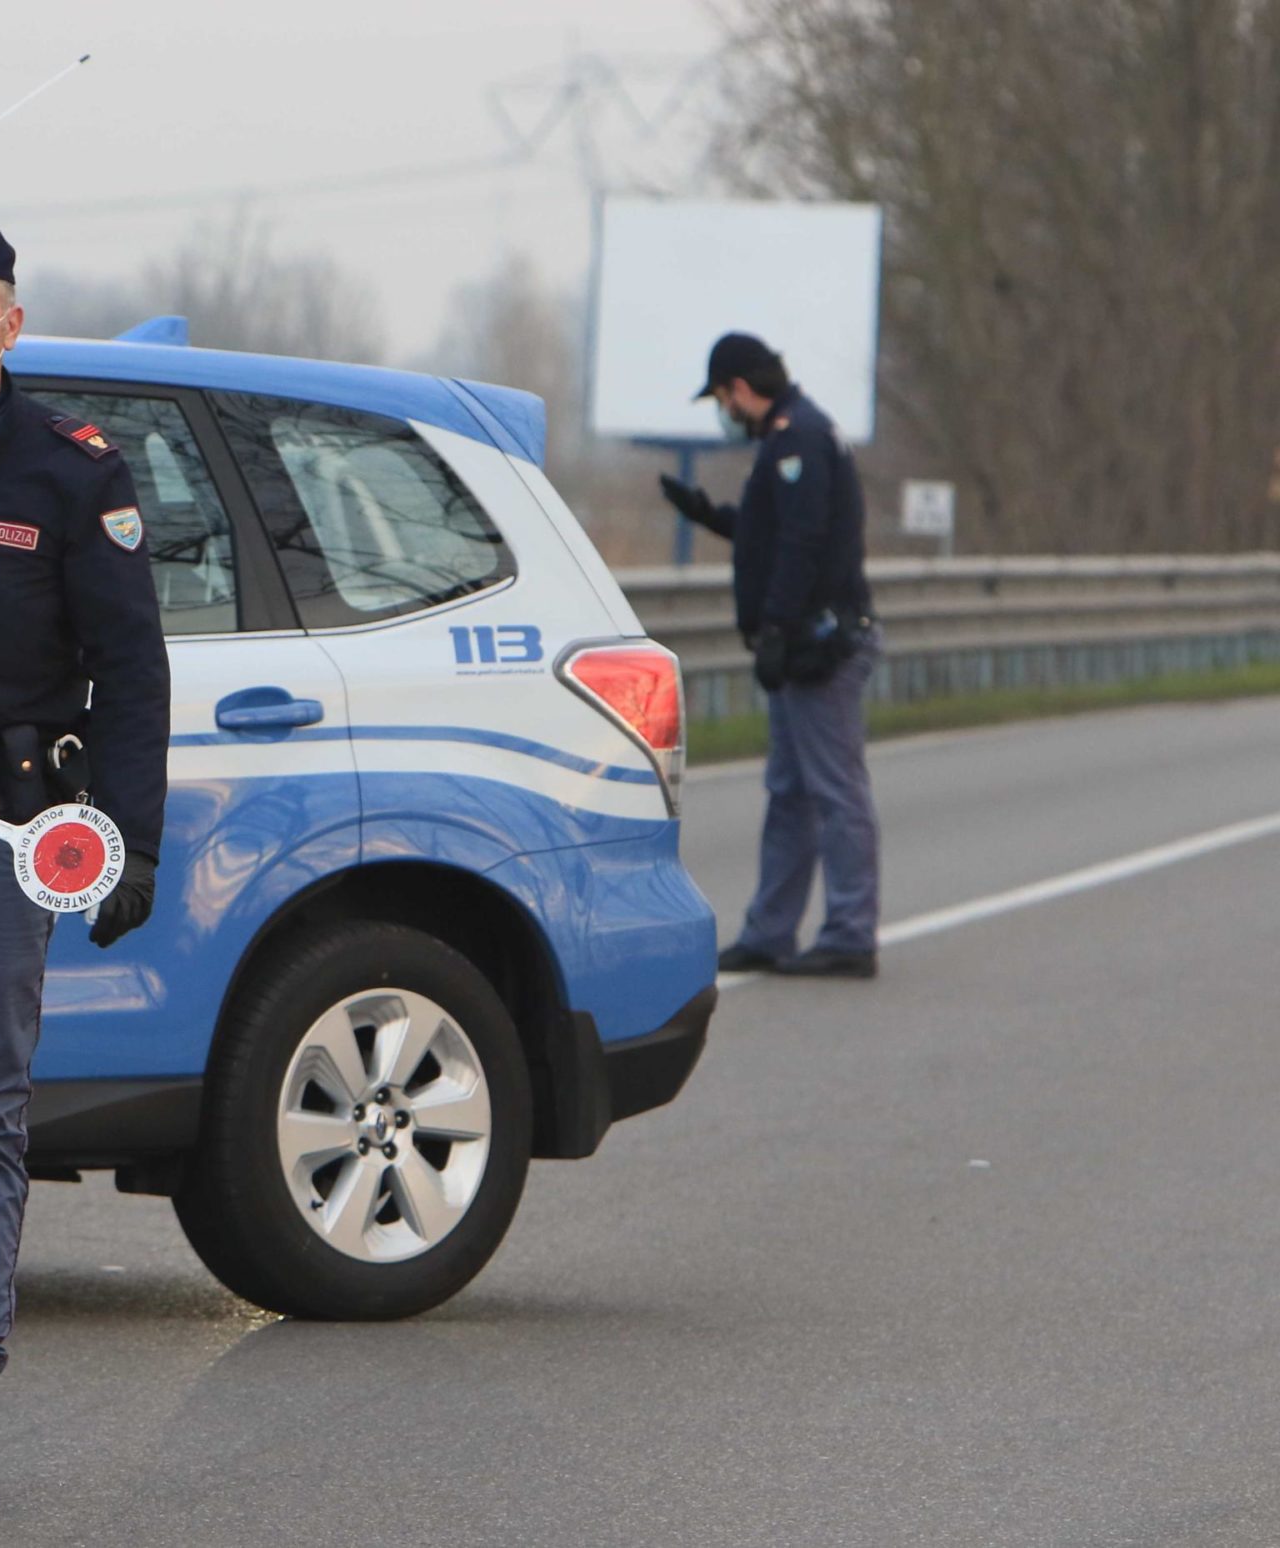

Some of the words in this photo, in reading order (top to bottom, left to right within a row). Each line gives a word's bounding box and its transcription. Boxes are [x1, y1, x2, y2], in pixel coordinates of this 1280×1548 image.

[448, 625, 544, 664] 113
[28, 809, 64, 835] POLIZIA
[78, 808, 121, 862] MINISTERO
[21, 838, 31, 849] DI
[18, 852, 30, 883] STATO
